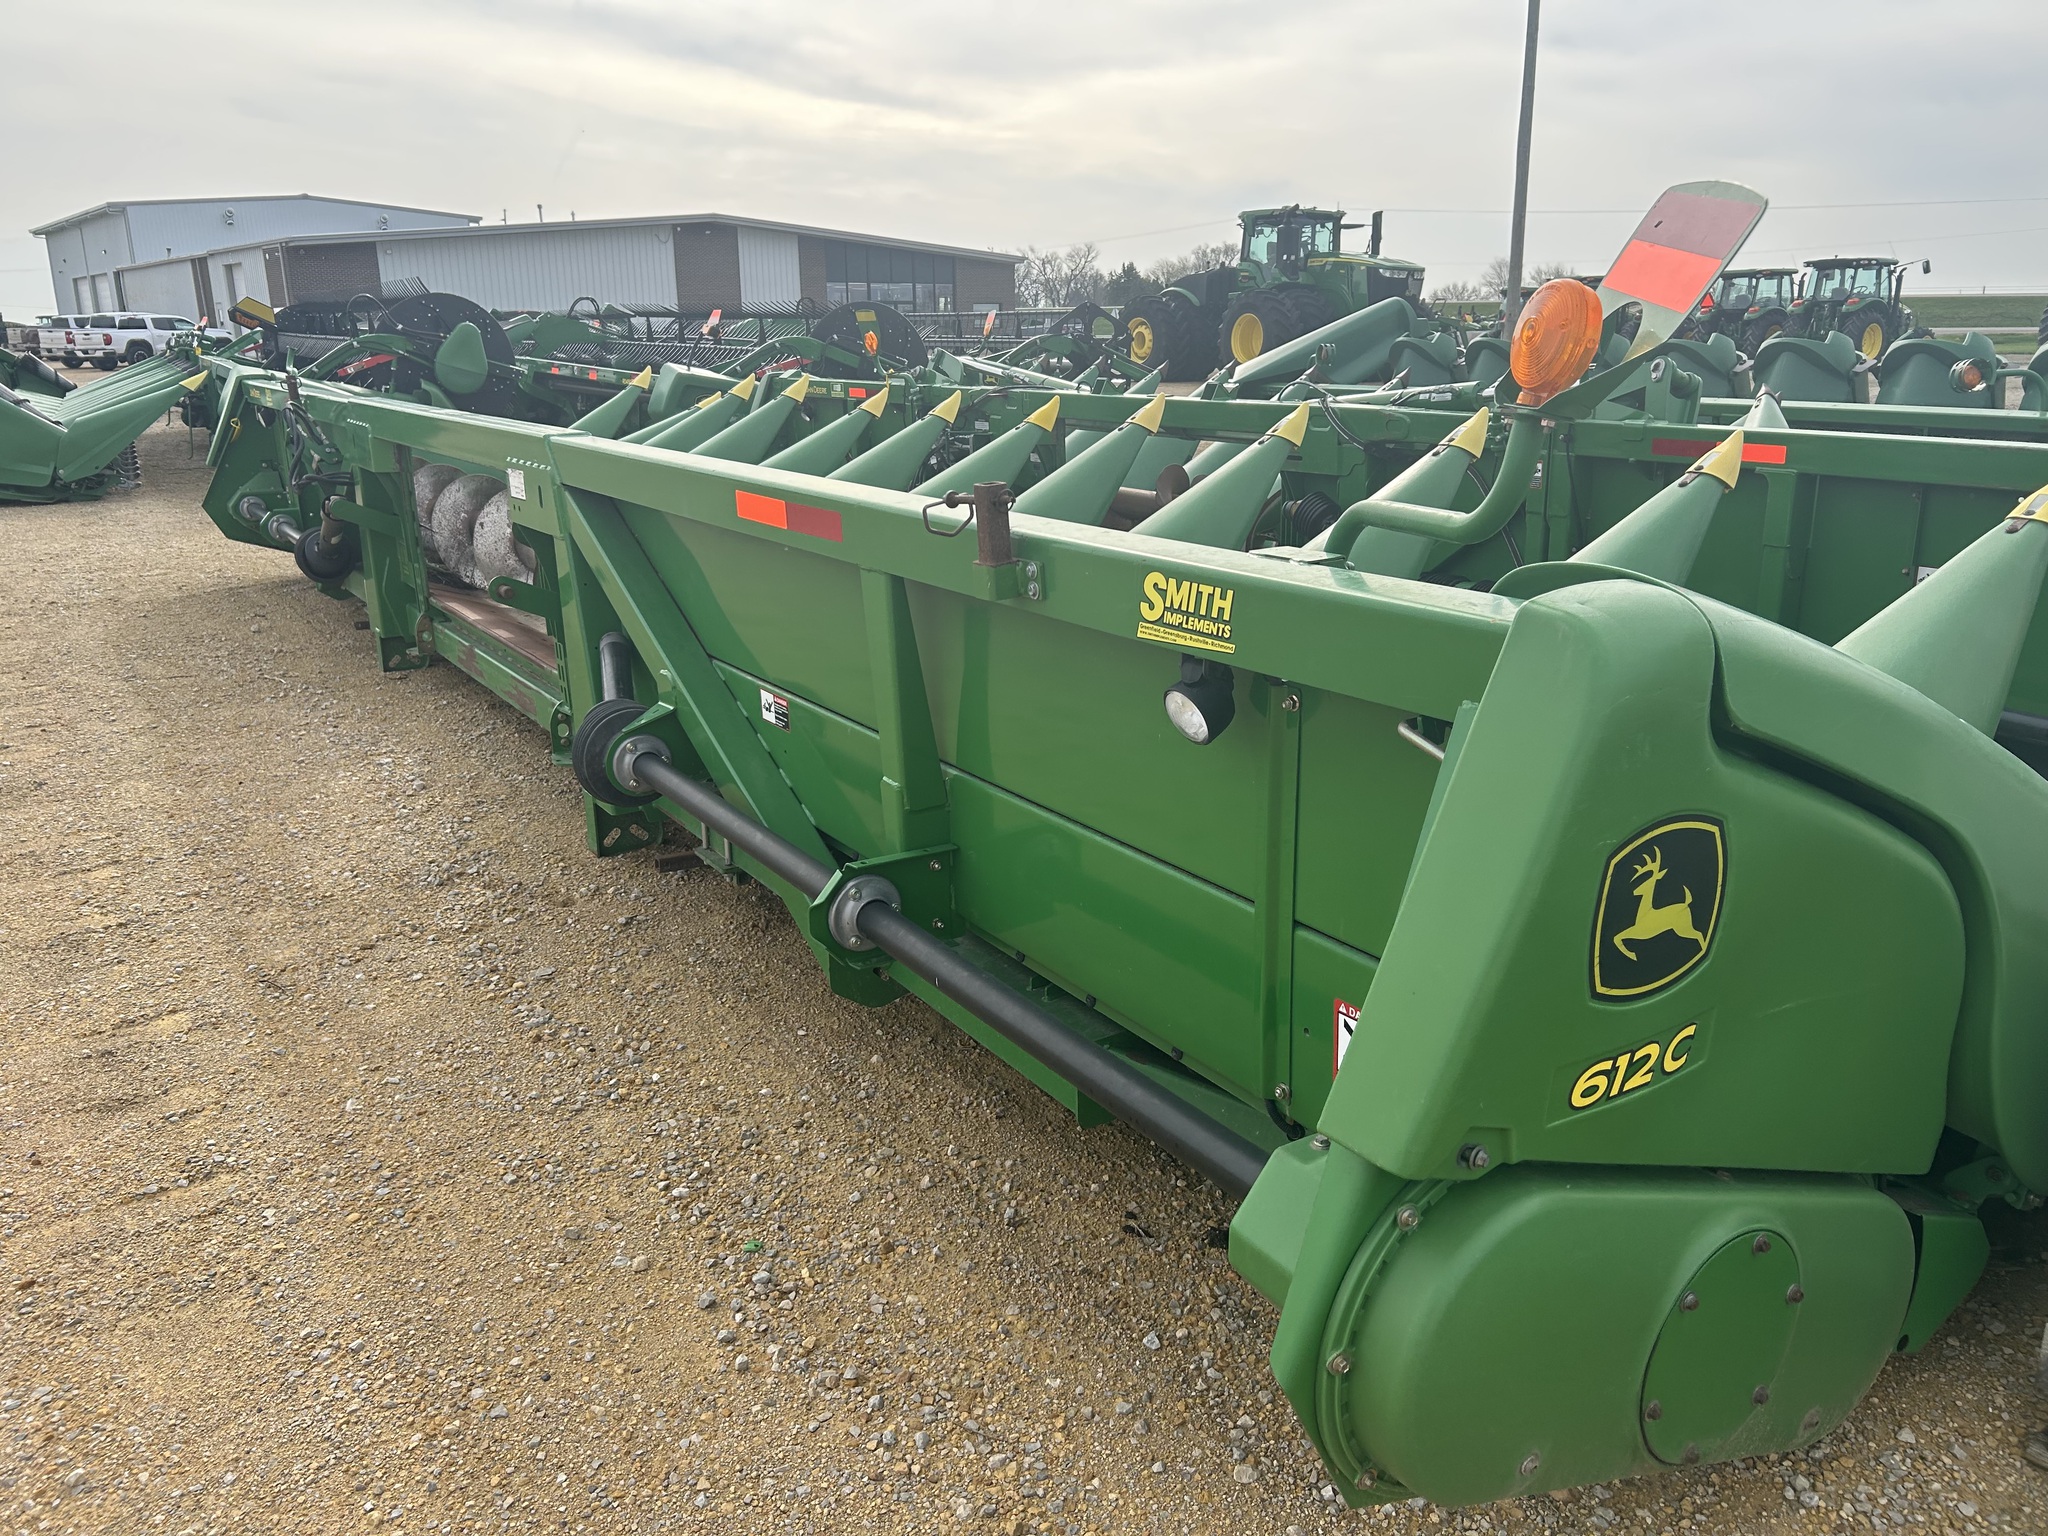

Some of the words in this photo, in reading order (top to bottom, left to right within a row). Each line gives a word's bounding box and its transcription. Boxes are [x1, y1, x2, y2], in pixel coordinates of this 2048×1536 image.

[1140, 571, 1234, 621] SMITH
[1163, 610, 1232, 639] IMPLEMENTS
[1569, 1022, 1698, 1109] 612C
